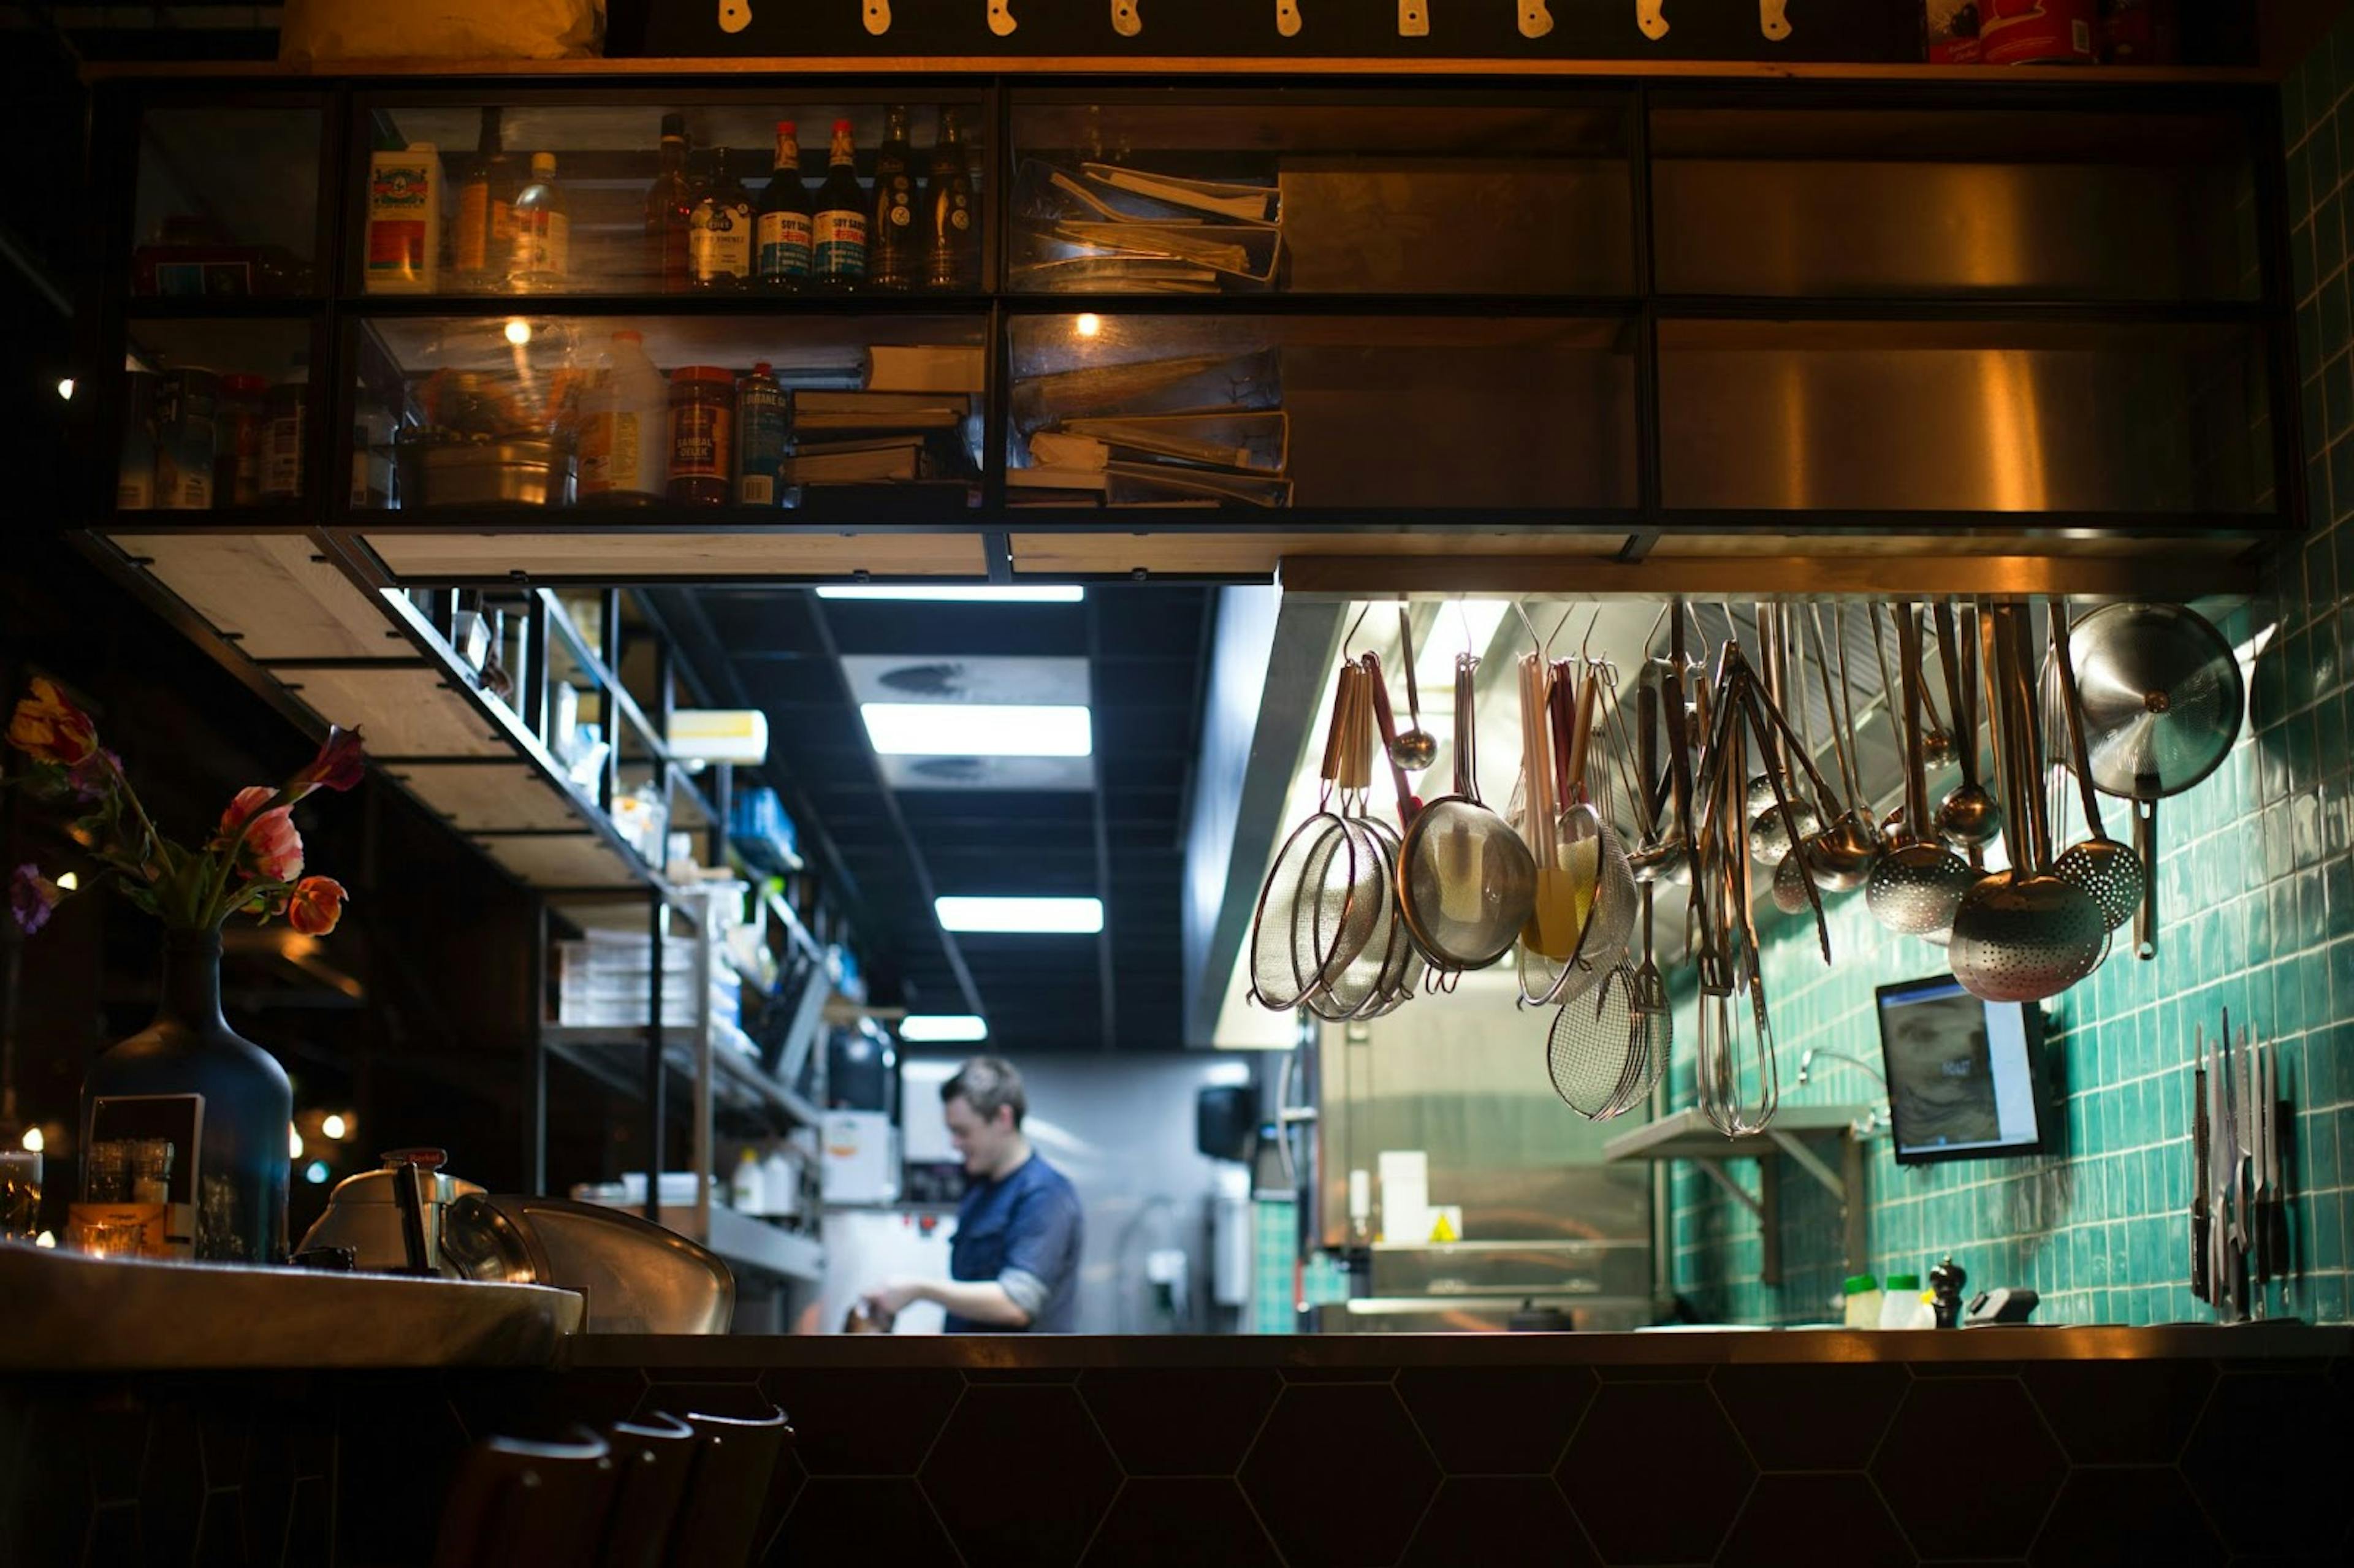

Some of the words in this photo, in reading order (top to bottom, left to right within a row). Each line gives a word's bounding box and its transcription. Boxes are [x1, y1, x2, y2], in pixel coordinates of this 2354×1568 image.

[782, 220, 796, 229] SOY
[834, 218, 847, 227] SOY
[677, 438, 711, 447] SAMBAL
